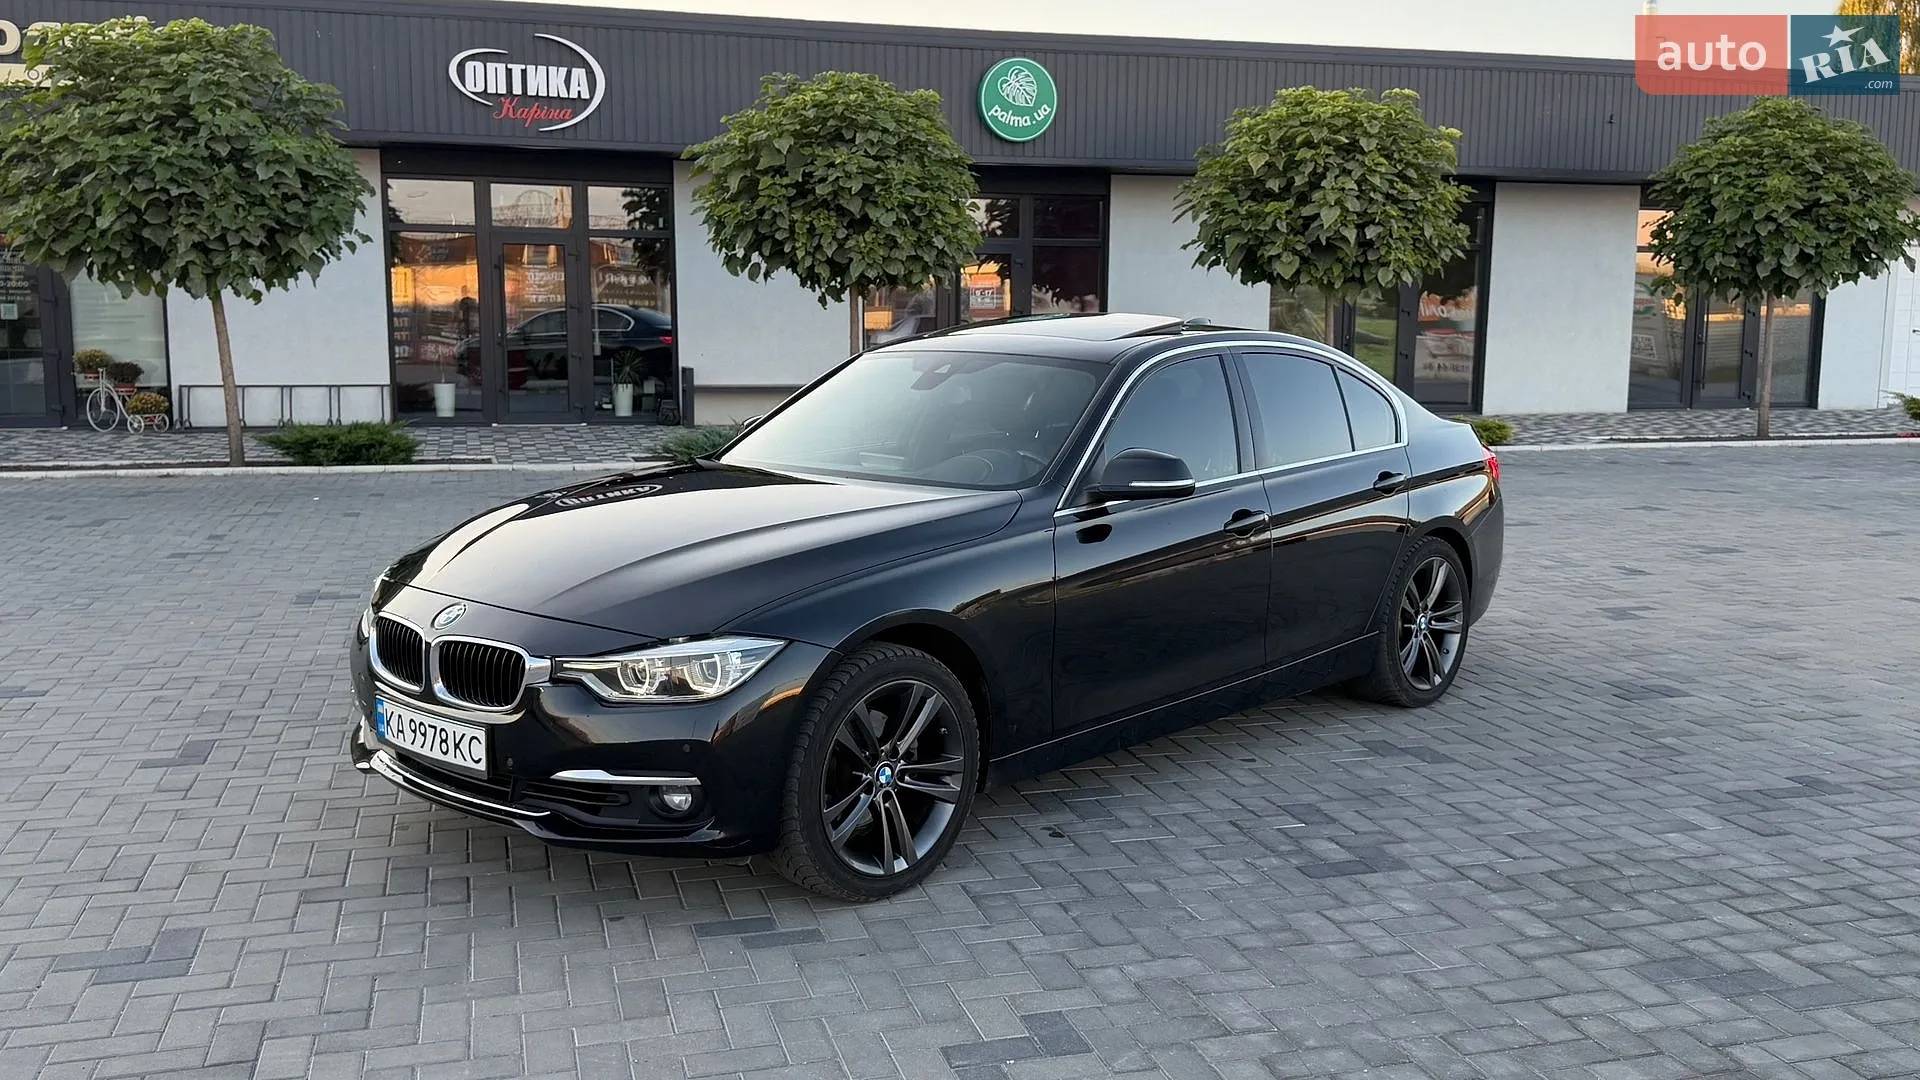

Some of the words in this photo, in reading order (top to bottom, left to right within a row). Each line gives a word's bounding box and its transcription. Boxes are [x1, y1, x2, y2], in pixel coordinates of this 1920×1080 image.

[464, 60, 590, 99] ОПТИКА
[493, 97, 574, 128] Каріна
[988, 104, 1052, 127] palma.ua
[408, 718, 450, 756] 9978
